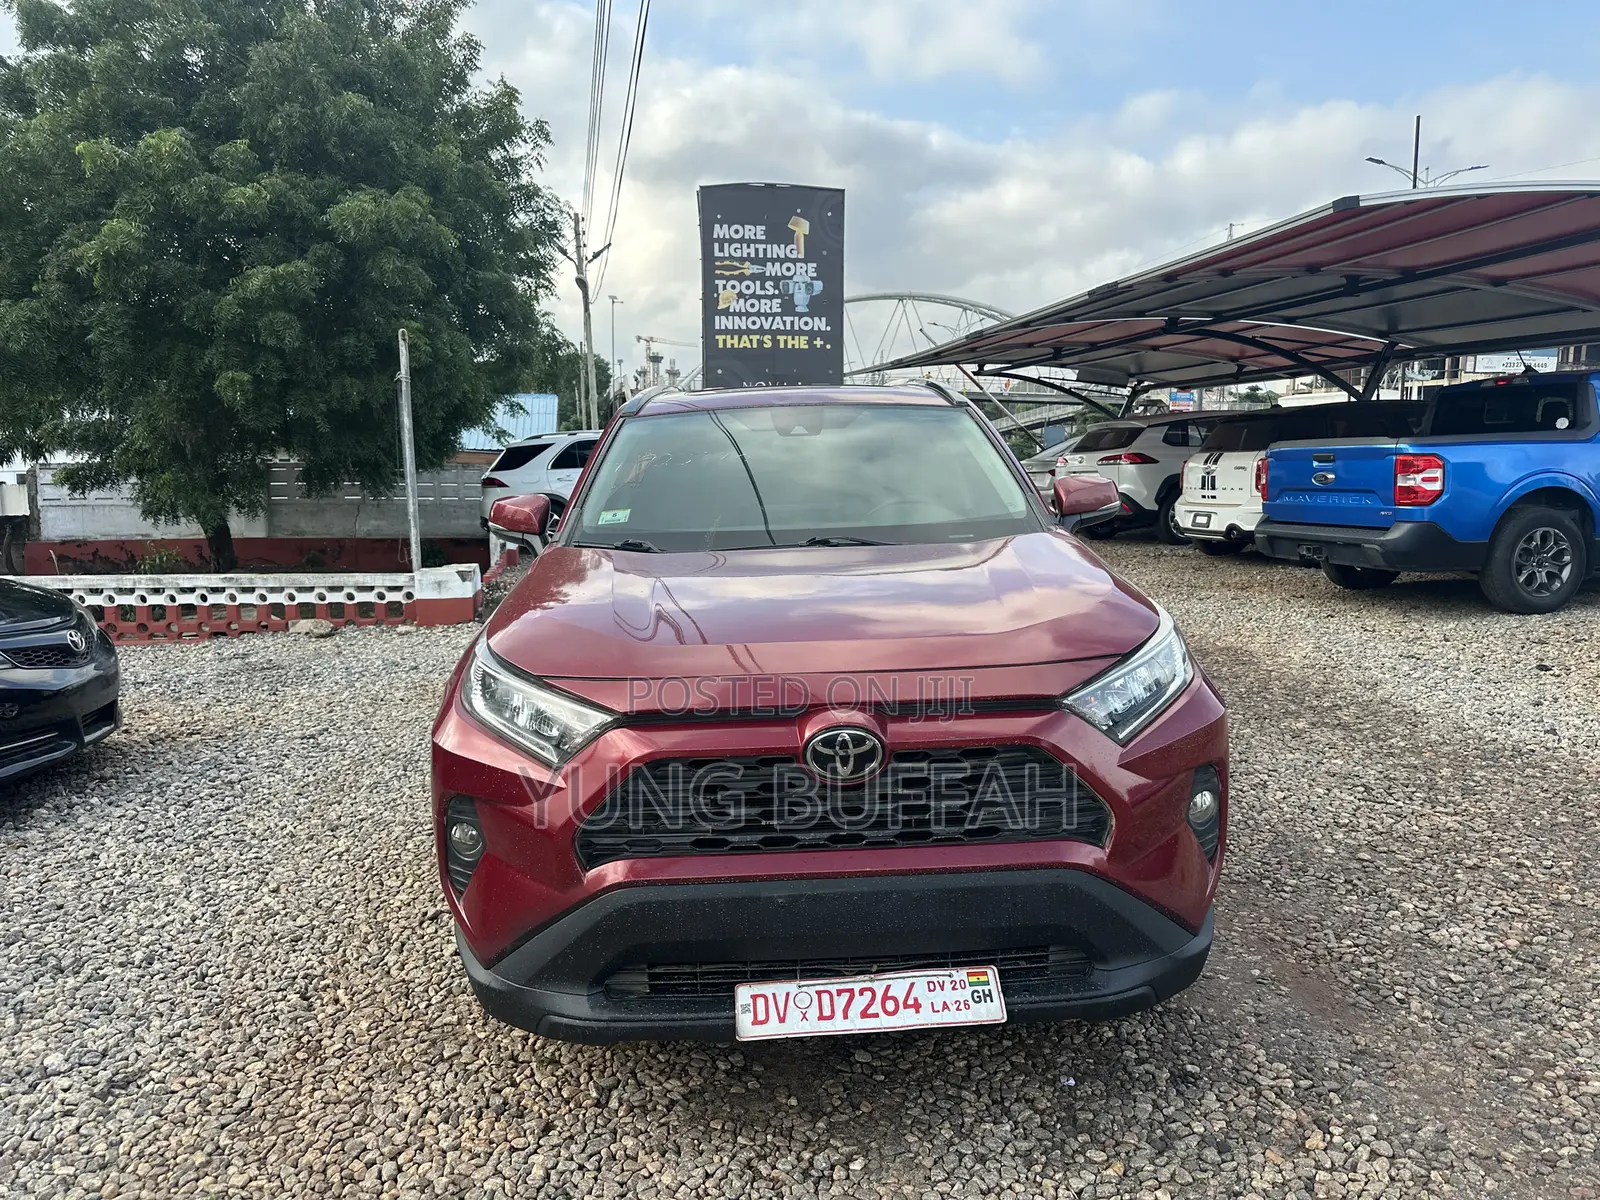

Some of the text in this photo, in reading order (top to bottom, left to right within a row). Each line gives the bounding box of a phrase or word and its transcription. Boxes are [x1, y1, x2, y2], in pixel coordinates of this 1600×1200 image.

[713, 224, 766, 240] MORE
[765, 262, 817, 277] MORE
[715, 280, 779, 295] TOOLS.
[729, 299, 782, 314] MORE
[714, 316, 832, 331] INNOVATION.
[715, 335, 773, 349] THAT'S
[777, 335, 809, 349] THE
[1283, 494, 1373, 504] MAVERICK
[927, 979, 967, 993] DV 20
[750, 991, 790, 1026] DV
[815, 982, 922, 1022] D7264
[970, 988, 994, 1005] GH
[931, 999, 971, 1014] LA 26
